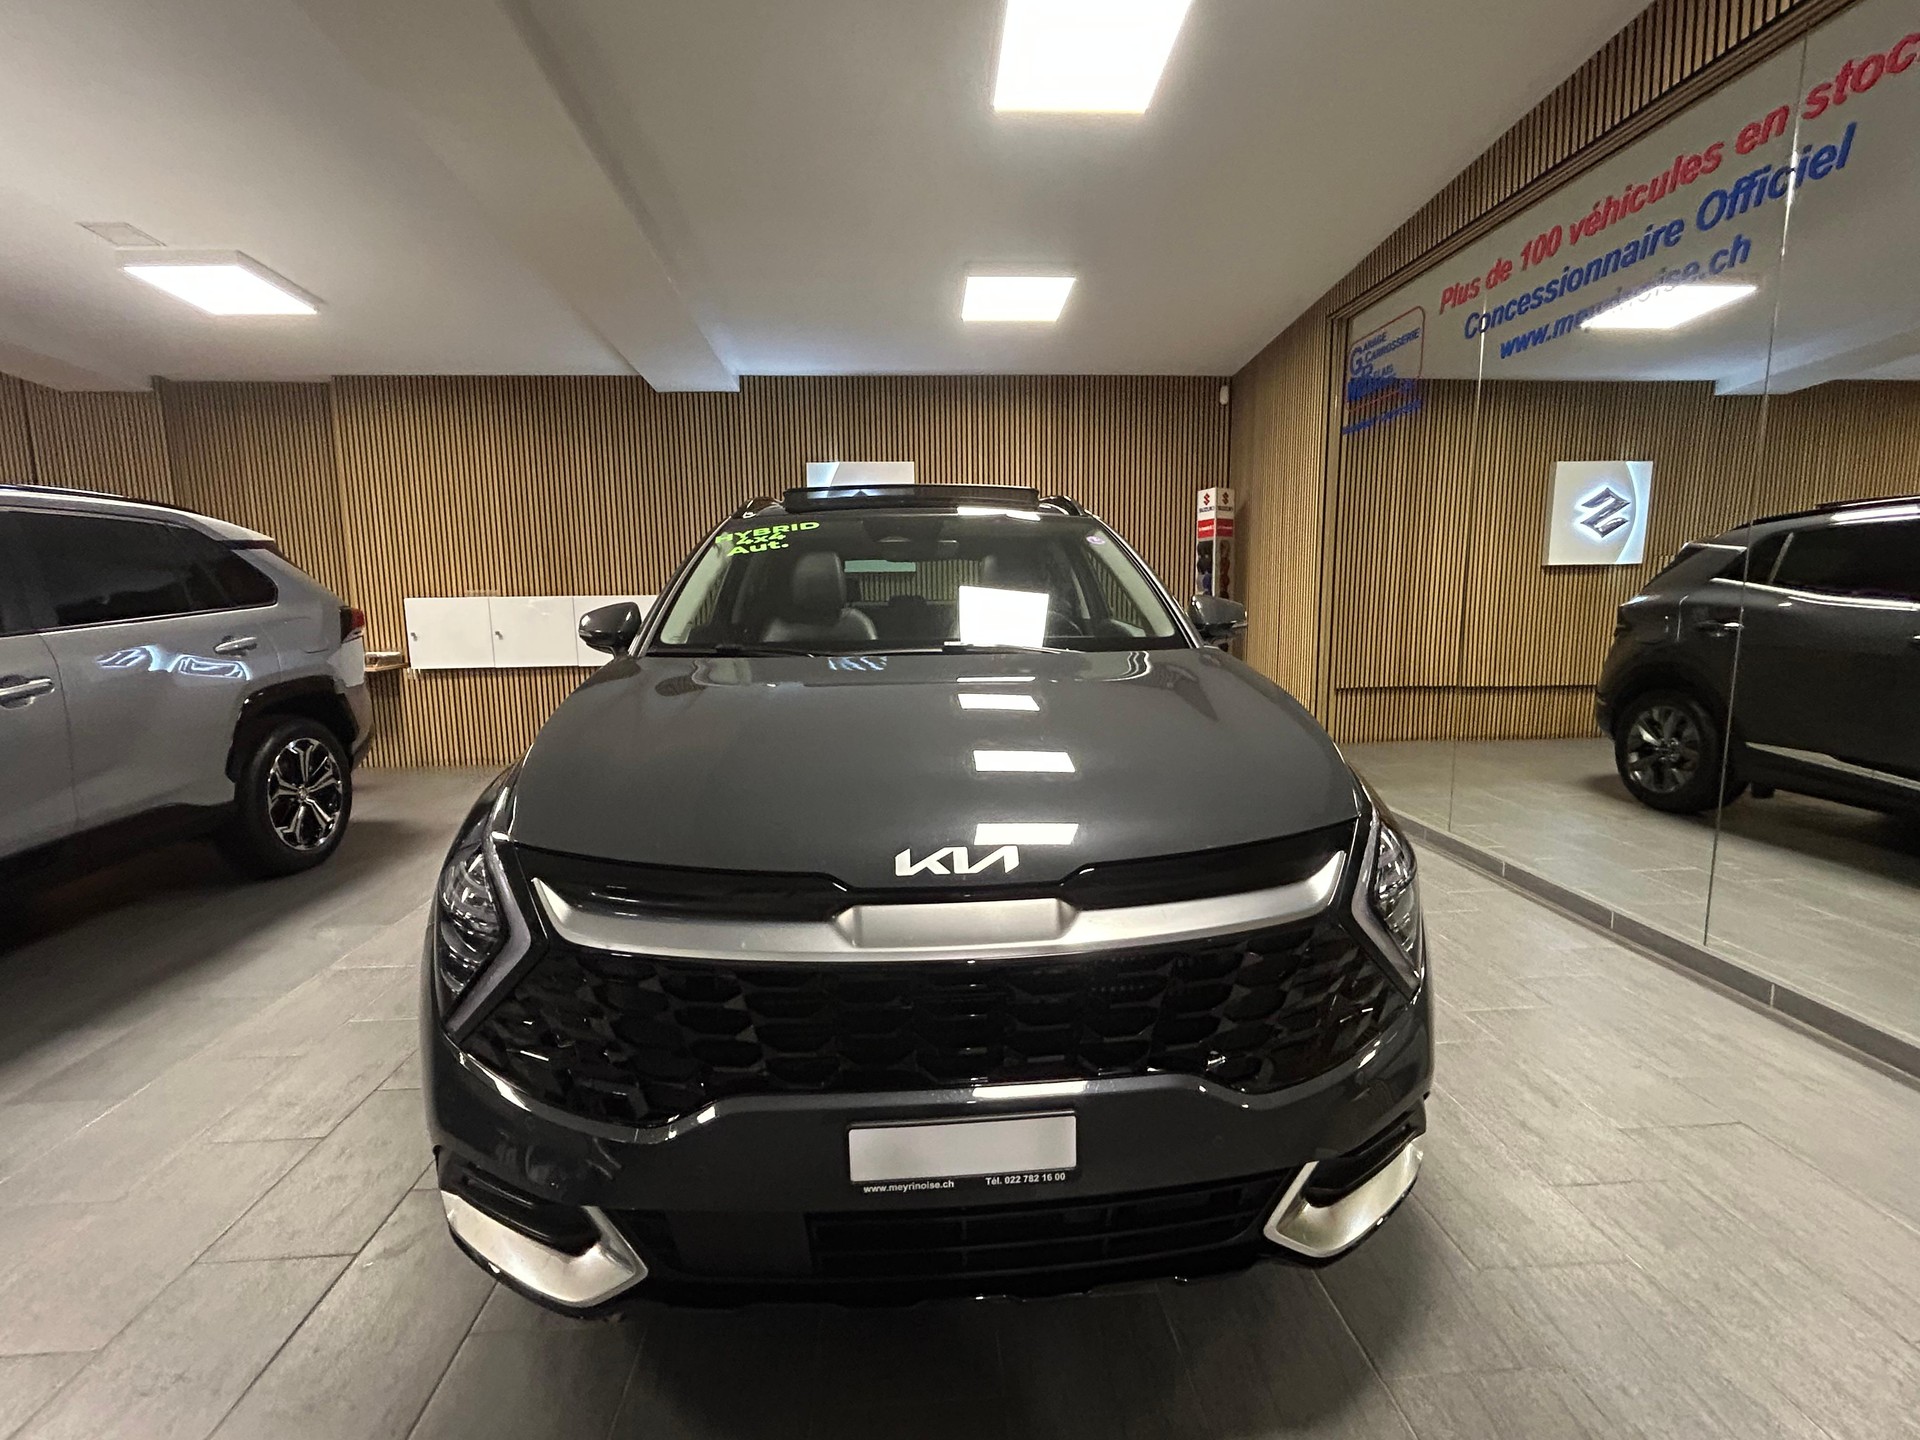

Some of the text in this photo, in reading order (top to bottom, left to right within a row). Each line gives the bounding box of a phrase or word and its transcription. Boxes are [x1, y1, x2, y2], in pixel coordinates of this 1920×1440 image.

[1439, 32, 1920, 315] Plus de 100 véhicules en stoc
[1464, 121, 1858, 339] Concessionnaire Officiel
[1499, 233, 1752, 359] www.meoise.ch
[715, 521, 820, 544] HYBRID
[736, 532, 787, 545] 4x4
[726, 540, 789, 557] Aut.
[895, 845, 1020, 877] KIA
[863, 1180, 955, 1194] www.meyrinoise.ch
[985, 1172, 1066, 1186] Tél. 022 782 16 00
